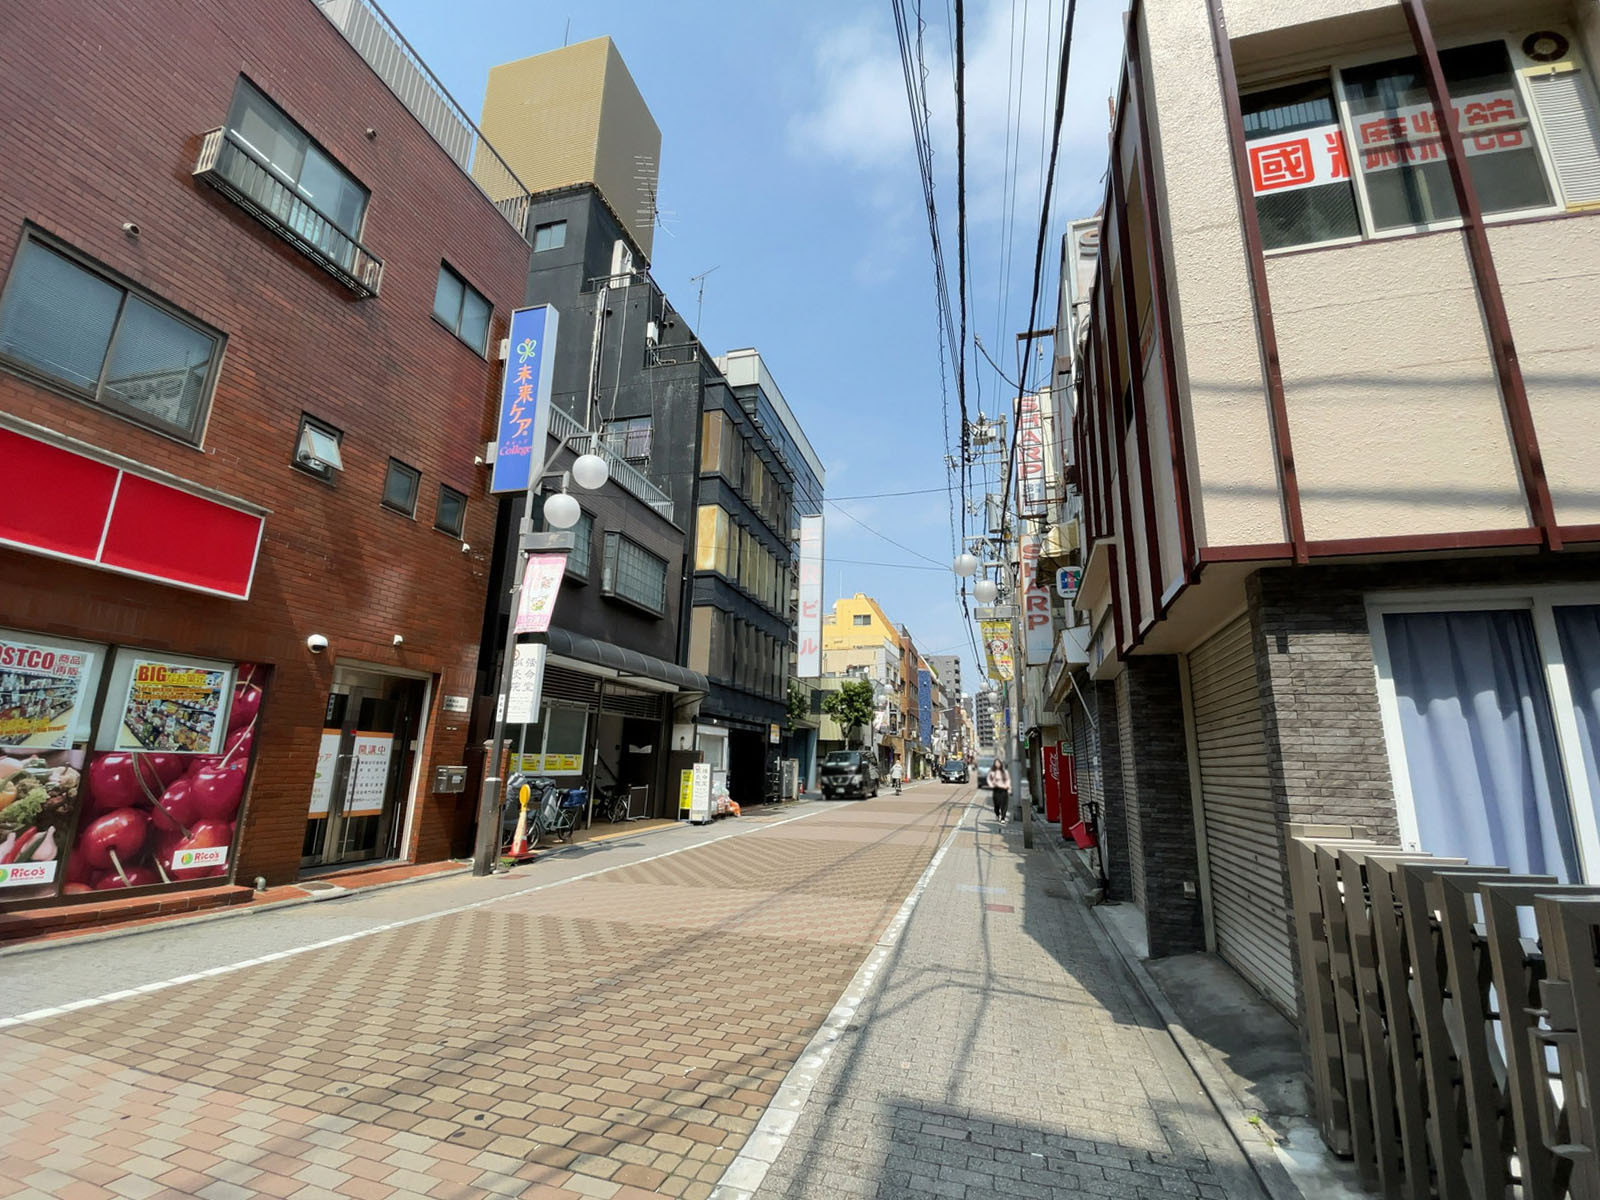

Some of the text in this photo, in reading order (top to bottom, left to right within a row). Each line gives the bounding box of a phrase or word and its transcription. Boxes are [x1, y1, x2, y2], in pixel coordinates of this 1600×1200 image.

[0, 645, 55, 670] STCO
[138, 665, 167, 682] BIG
[194, 850, 220, 861] Rico's
[10, 866, 46, 878] Rico's
